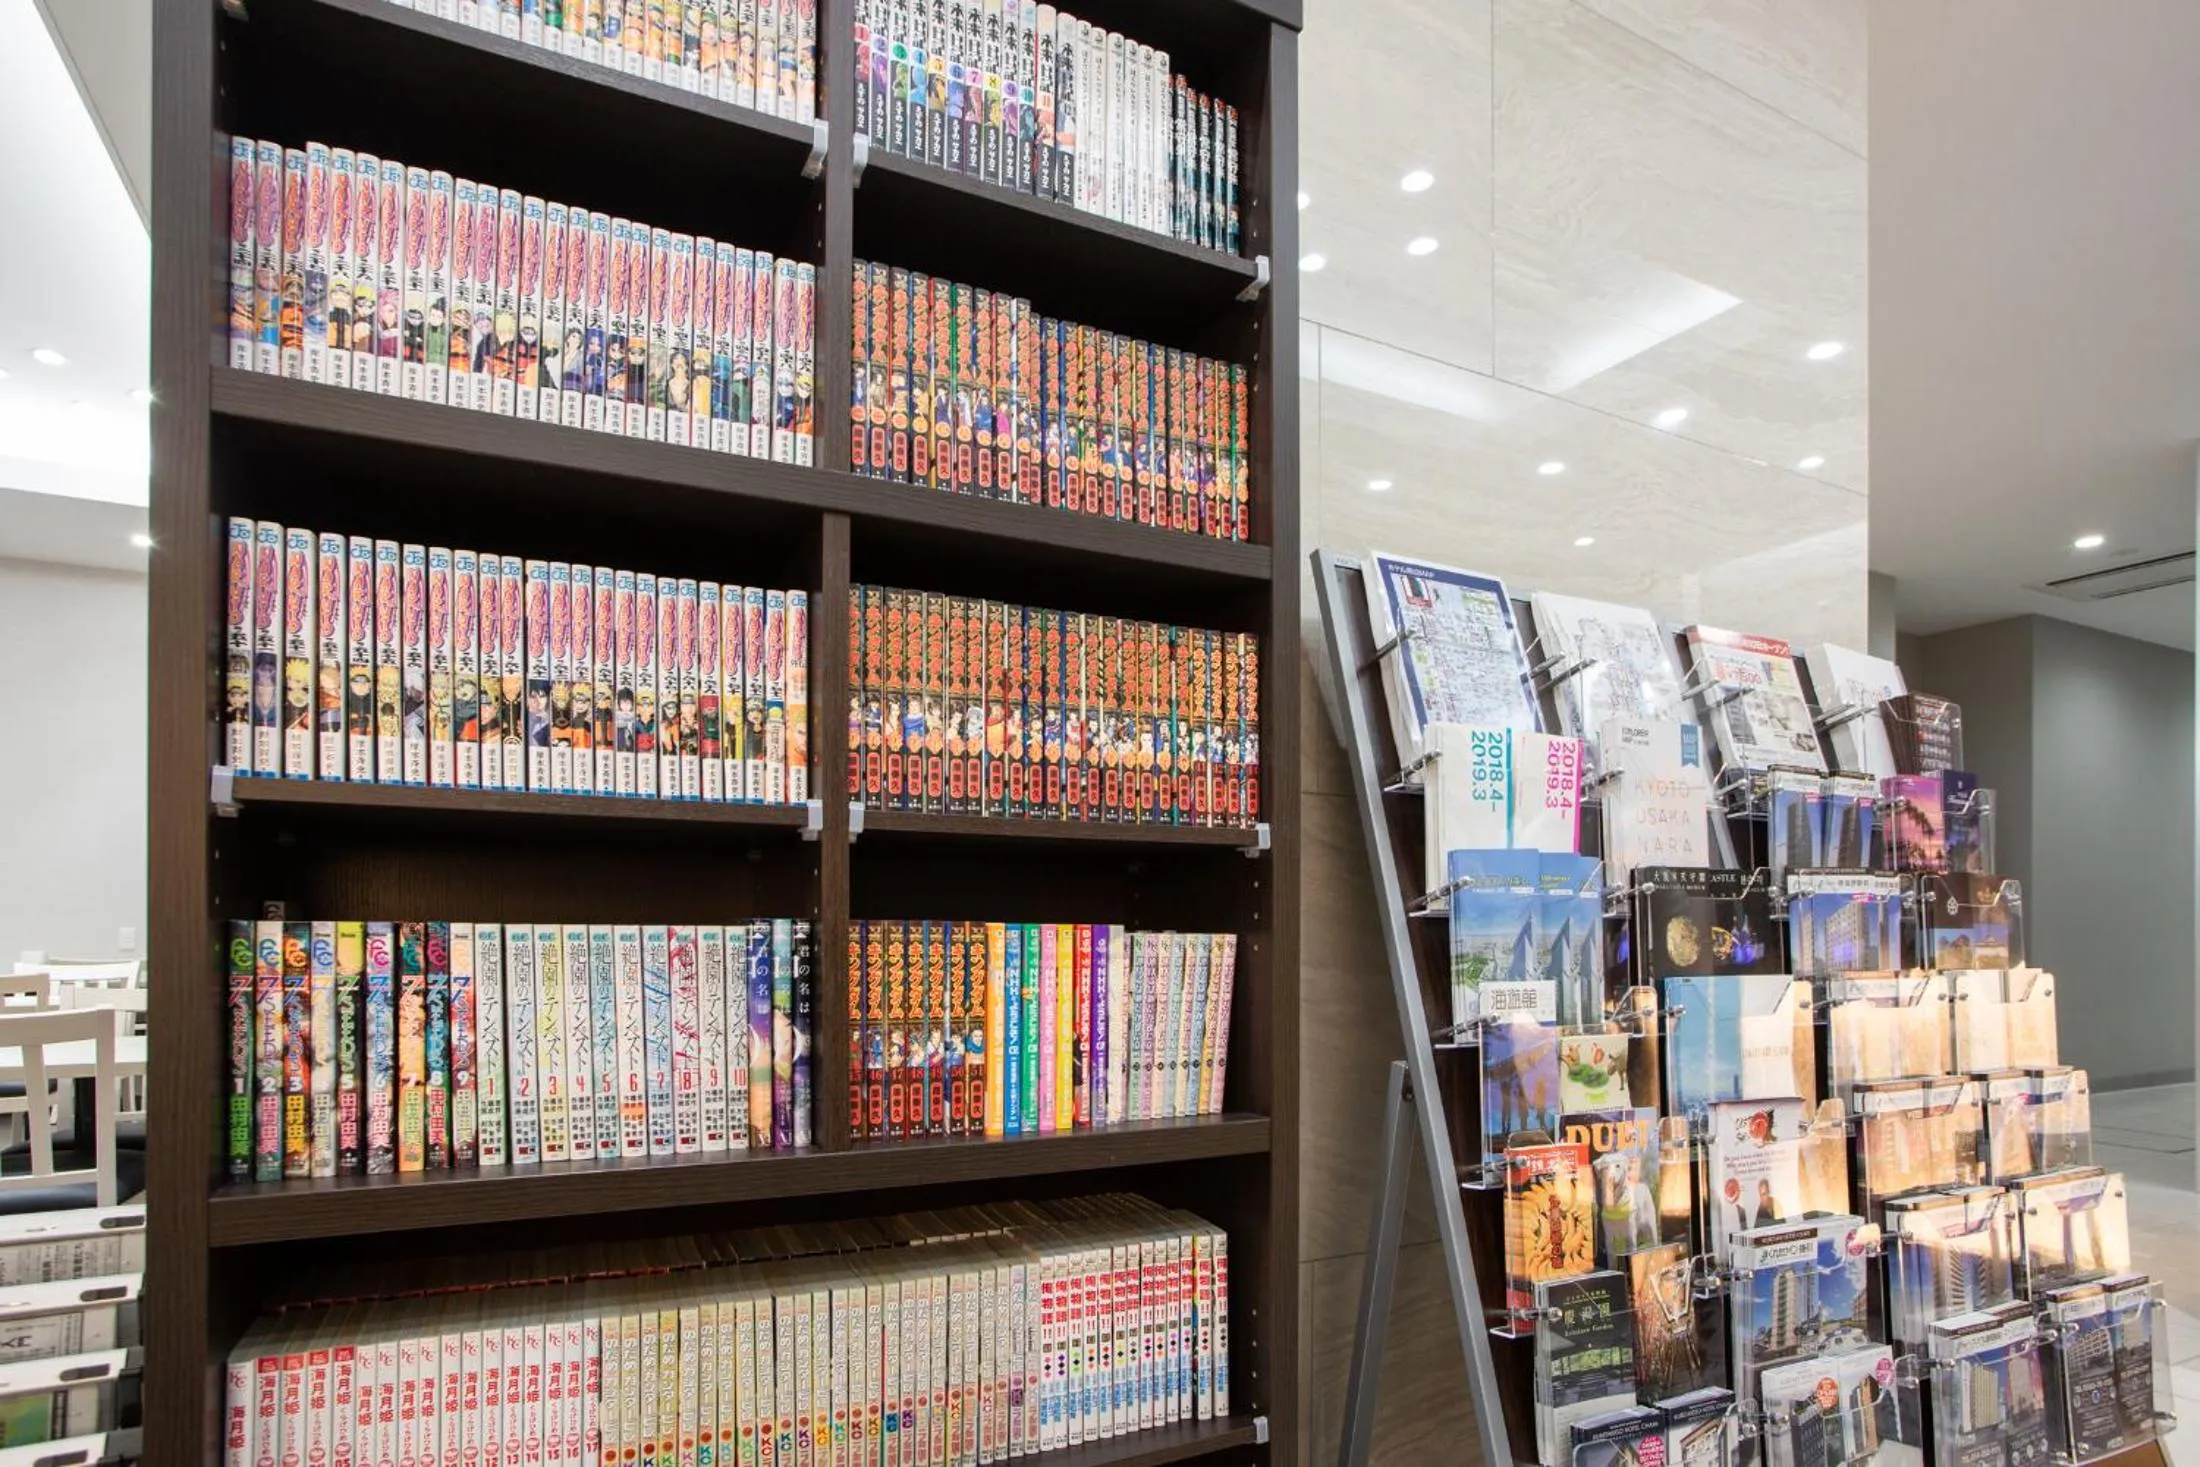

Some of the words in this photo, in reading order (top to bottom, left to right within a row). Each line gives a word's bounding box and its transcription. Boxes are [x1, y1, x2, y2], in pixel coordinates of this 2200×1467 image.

[1471, 730, 1488, 802] 2019.3
[1546, 740, 1562, 810] 2019.3
[1635, 778, 1690, 798] KYOTO
[1636, 808, 1690, 824] OSAKA
[868, 942, 882, 1018] キングダム
[889, 942, 904, 1018] キングダム
[909, 942, 923, 1018] キングダム
[929, 942, 944, 1017] キングダム
[970, 942, 985, 1016] キングダム
[480, 942, 499, 1075] 絶園のテンペスト
[513, 943, 533, 1074] 絶園のテンペスト
[540, 943, 561, 1073] 絶園のテンペスト
[569, 943, 589, 1072] 絶園のテンペスト
[593, 943, 614, 1071] 絶園のテンペスト
[621, 943, 640, 1070] 絶園のテンペスト
[703, 943, 723, 1067] 絶園のテンペスト
[729, 943, 748, 1067] 絶園のテンペスト
[234, 1077, 245, 1094] 1
[261, 1077, 277, 1093] 2
[289, 1076, 303, 1091] 3
[341, 1073, 354, 1089] 5
[431, 1070, 443, 1085] 8
[457, 1070, 469, 1086] 9
[487, 1077, 495, 1095] 1
[520, 1078, 529, 1096] 2
[548, 1075, 557, 1095] 3
[576, 1075, 585, 1092] 4
[602, 1073, 611, 1093] 5
[630, 1072, 638, 1092] 6
[656, 1072, 664, 1089] 7
[709, 1069, 718, 1087] 9
[336, 1365, 351, 1404] 海月姫
[446, 1373, 458, 1412] 海月姫
[507, 1366, 520, 1404] 海月姫
[527, 1365, 539, 1403] 海月姫
[548, 1362, 561, 1399] 海月姫
[568, 1361, 580, 1398] 海月姫
[587, 1356, 599, 1393] 海月姫
[260, 1376, 275, 1418] 海月姫
[284, 1374, 300, 1415] 海月姫
[380, 1383, 394, 1422] 海月姫
[422, 1377, 435, 1417] 海月姫
[230, 1406, 246, 1449] 海月姫
[507, 1454, 519, 1464] 13
[526, 1452, 539, 1463] 14
[548, 1449, 560, 1460] 15
[567, 1447, 579, 1459] 16
[587, 1442, 598, 1453] 17
